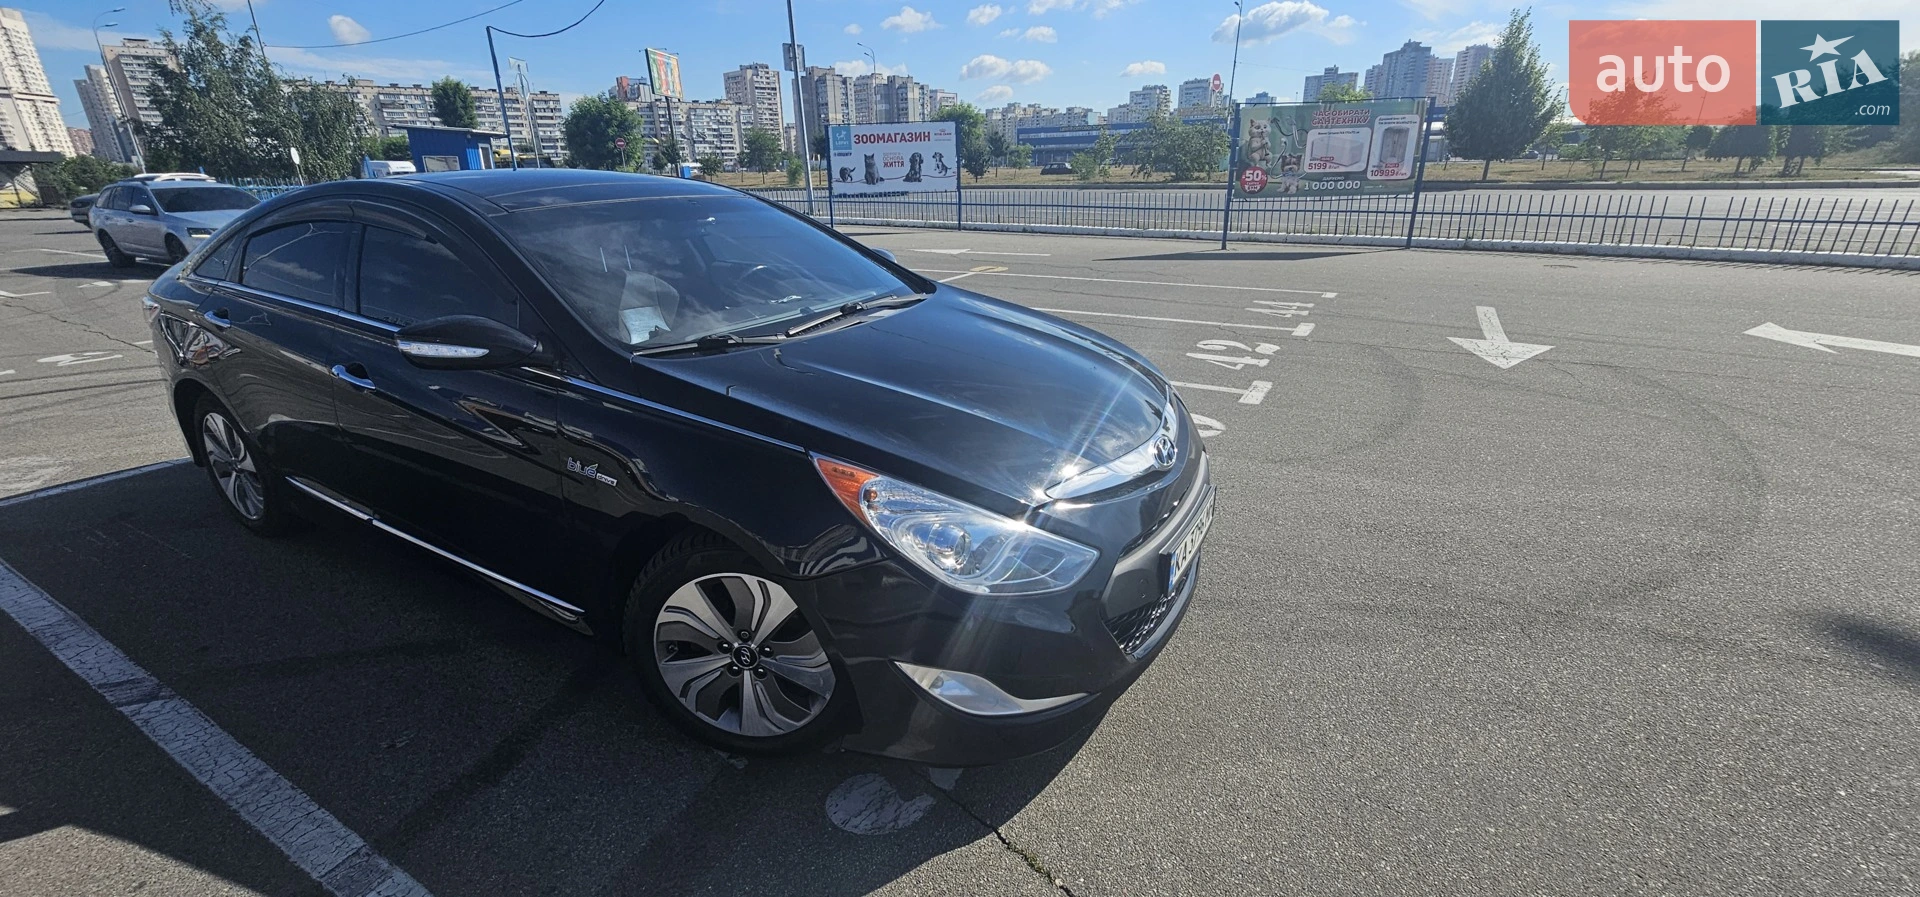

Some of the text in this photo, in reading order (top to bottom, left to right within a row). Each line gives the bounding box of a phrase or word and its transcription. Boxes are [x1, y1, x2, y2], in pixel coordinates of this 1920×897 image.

[1312, 108, 1371, 117] ЧАС ОБИРАТИ
[1311, 116, 1371, 126] САНТЕХНІКУ
[853, 131, 931, 145] ЗООМАГАЗИН
[882, 160, 905, 168] ЖИТТЯ
[1307, 162, 1328, 170] 5199
[1241, 169, 1267, 182] -50%
[1370, 169, 1396, 177] 10999
[1312, 181, 1335, 190] 000
[1337, 180, 1361, 189] 000
